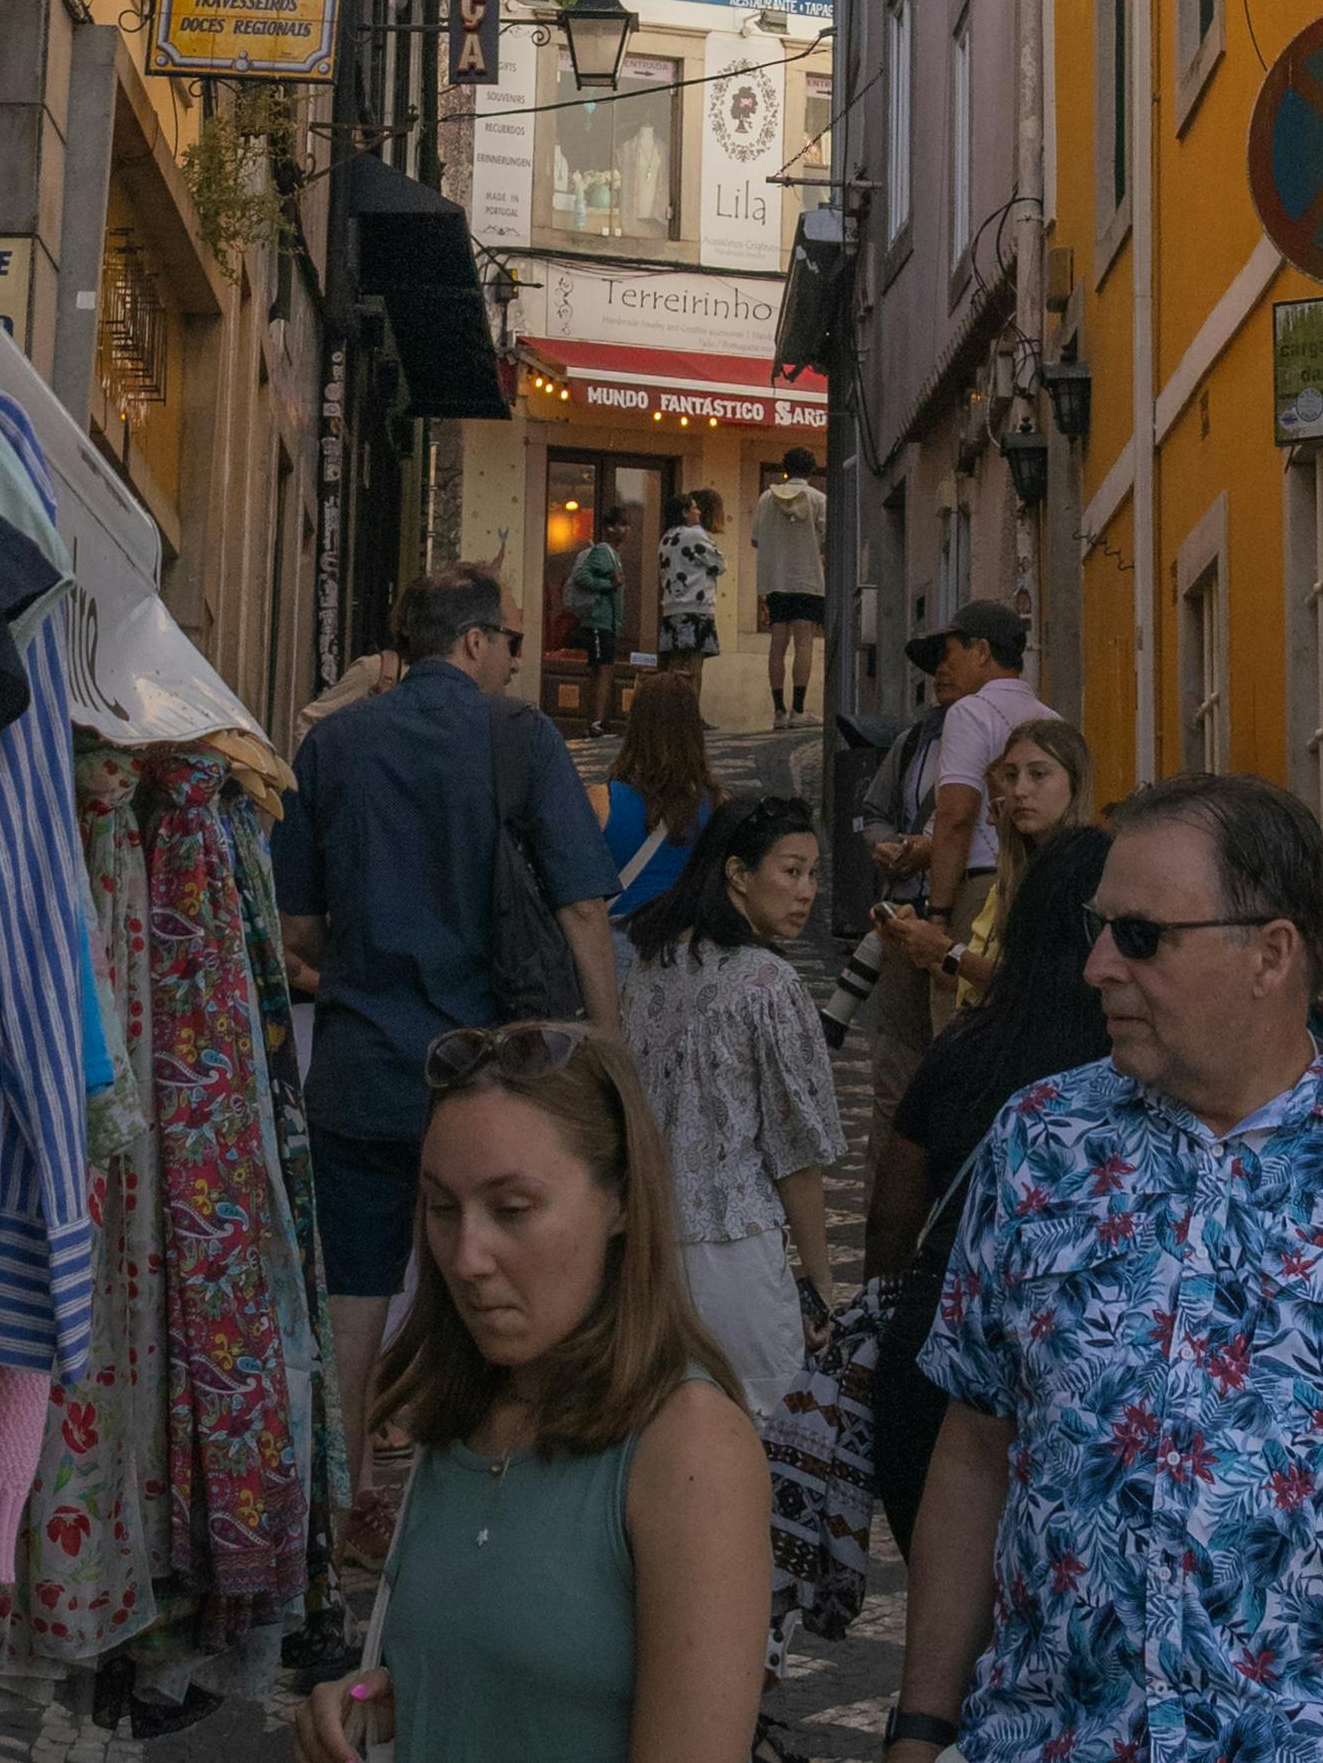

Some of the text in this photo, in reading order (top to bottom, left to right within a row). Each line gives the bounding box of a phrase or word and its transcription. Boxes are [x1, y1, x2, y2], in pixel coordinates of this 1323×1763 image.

[180, 17, 312, 38] DOCES REGIONAIS
[625, 59, 669, 72] ENTRADA
[807, 78, 831, 88] ENTR
[486, 91, 526, 104] SOUVENIRS
[484, 122, 525, 135] RECUERDOS
[477, 153, 531, 168] ERINNERUNGEN
[485, 192, 519, 203] MADE IN
[717, 180, 767, 226] Lila
[485, 206, 519, 219] PORTUGAL
[602, 278, 773, 321] Terreirinho
[587, 385, 827, 428] MUNDO FANTÁSTICO SARD
